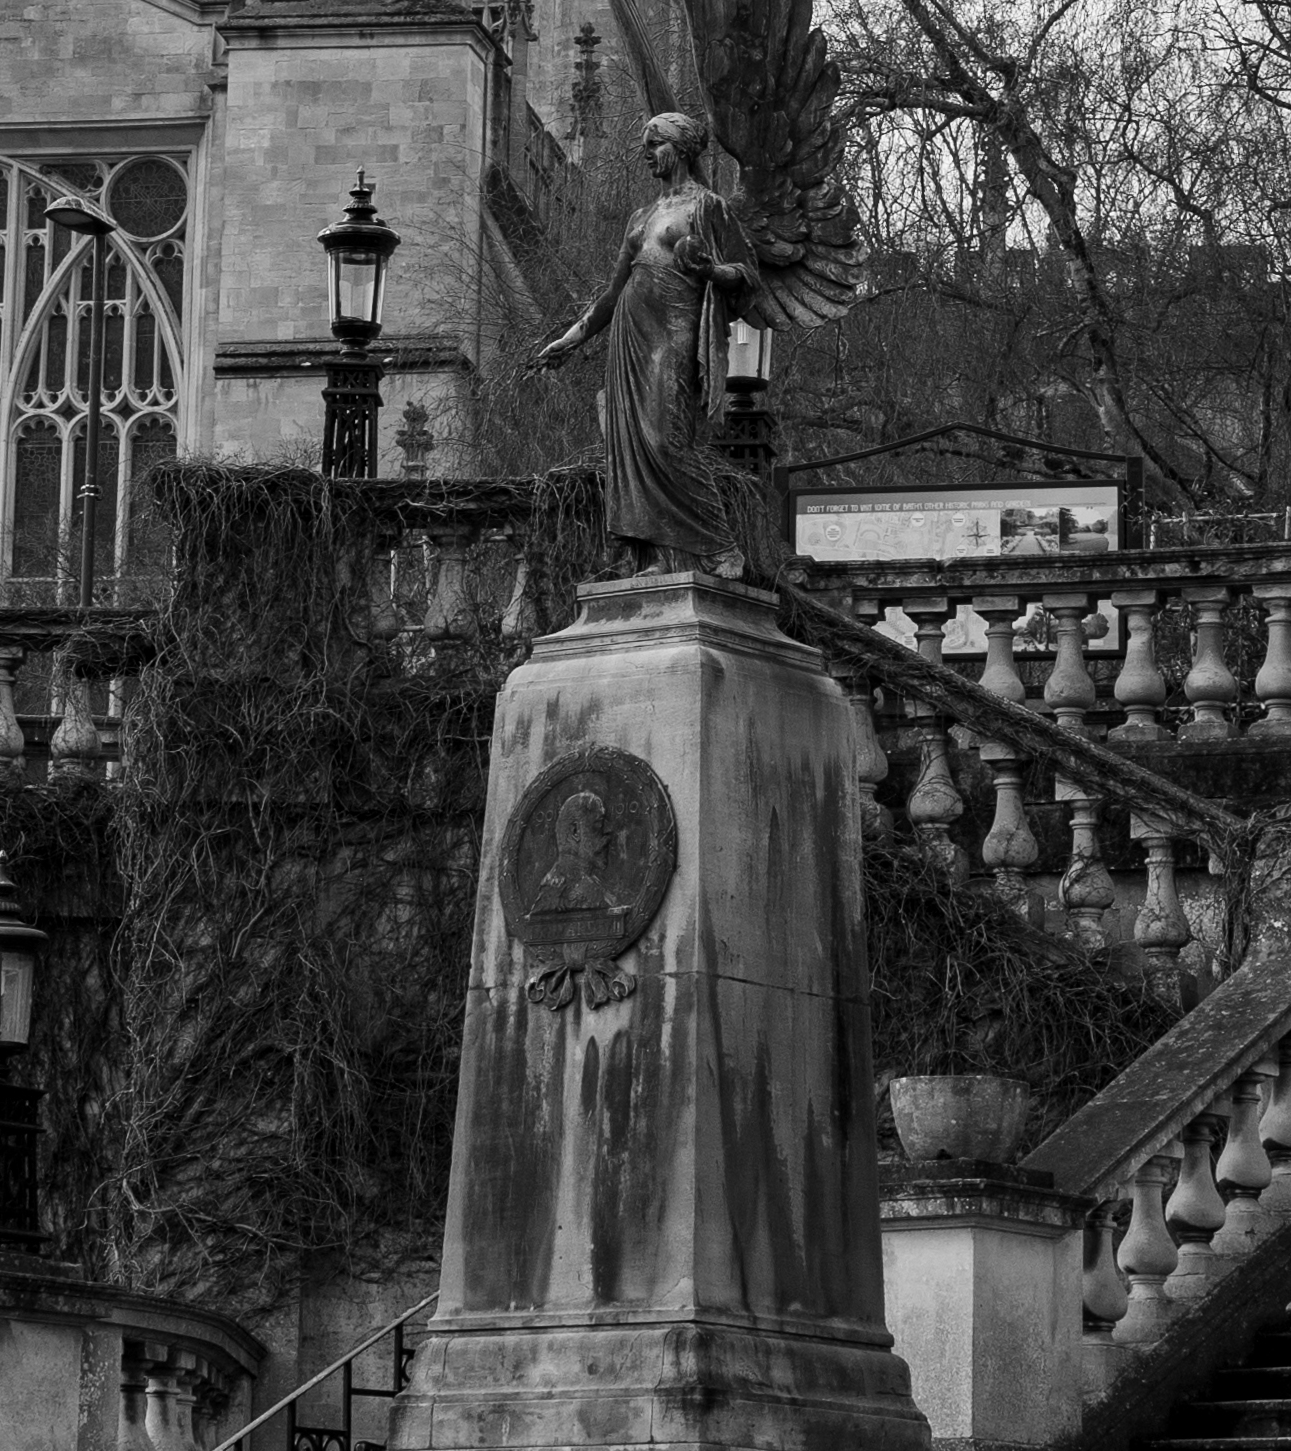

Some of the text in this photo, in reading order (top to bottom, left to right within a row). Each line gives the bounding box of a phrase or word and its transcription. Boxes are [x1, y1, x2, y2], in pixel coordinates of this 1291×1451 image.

[826, 504, 849, 512] FORGET
[851, 504, 858, 512] TO
[893, 502, 901, 510] OF
[991, 500, 1004, 508] AND
